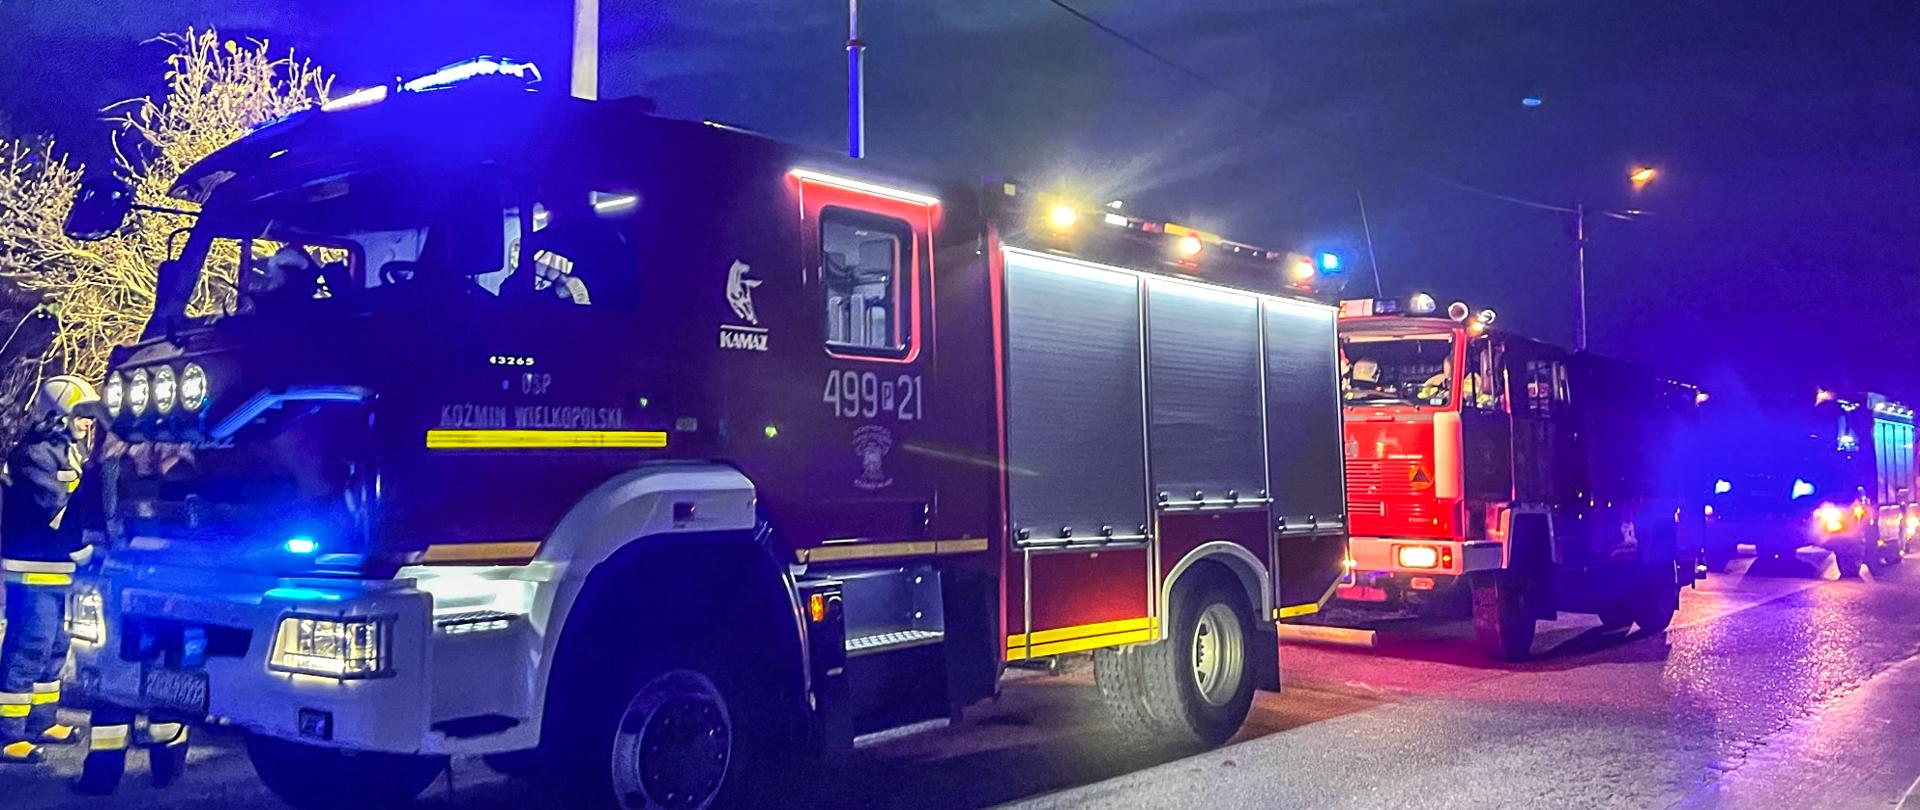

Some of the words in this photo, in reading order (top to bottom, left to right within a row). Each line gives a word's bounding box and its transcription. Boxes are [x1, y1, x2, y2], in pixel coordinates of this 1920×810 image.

[720, 331, 768, 351] KAMAZ
[489, 356, 534, 365] 43265
[522, 372, 552, 395] OSP
[514, 405, 623, 429] WIELKOPOLSKI
